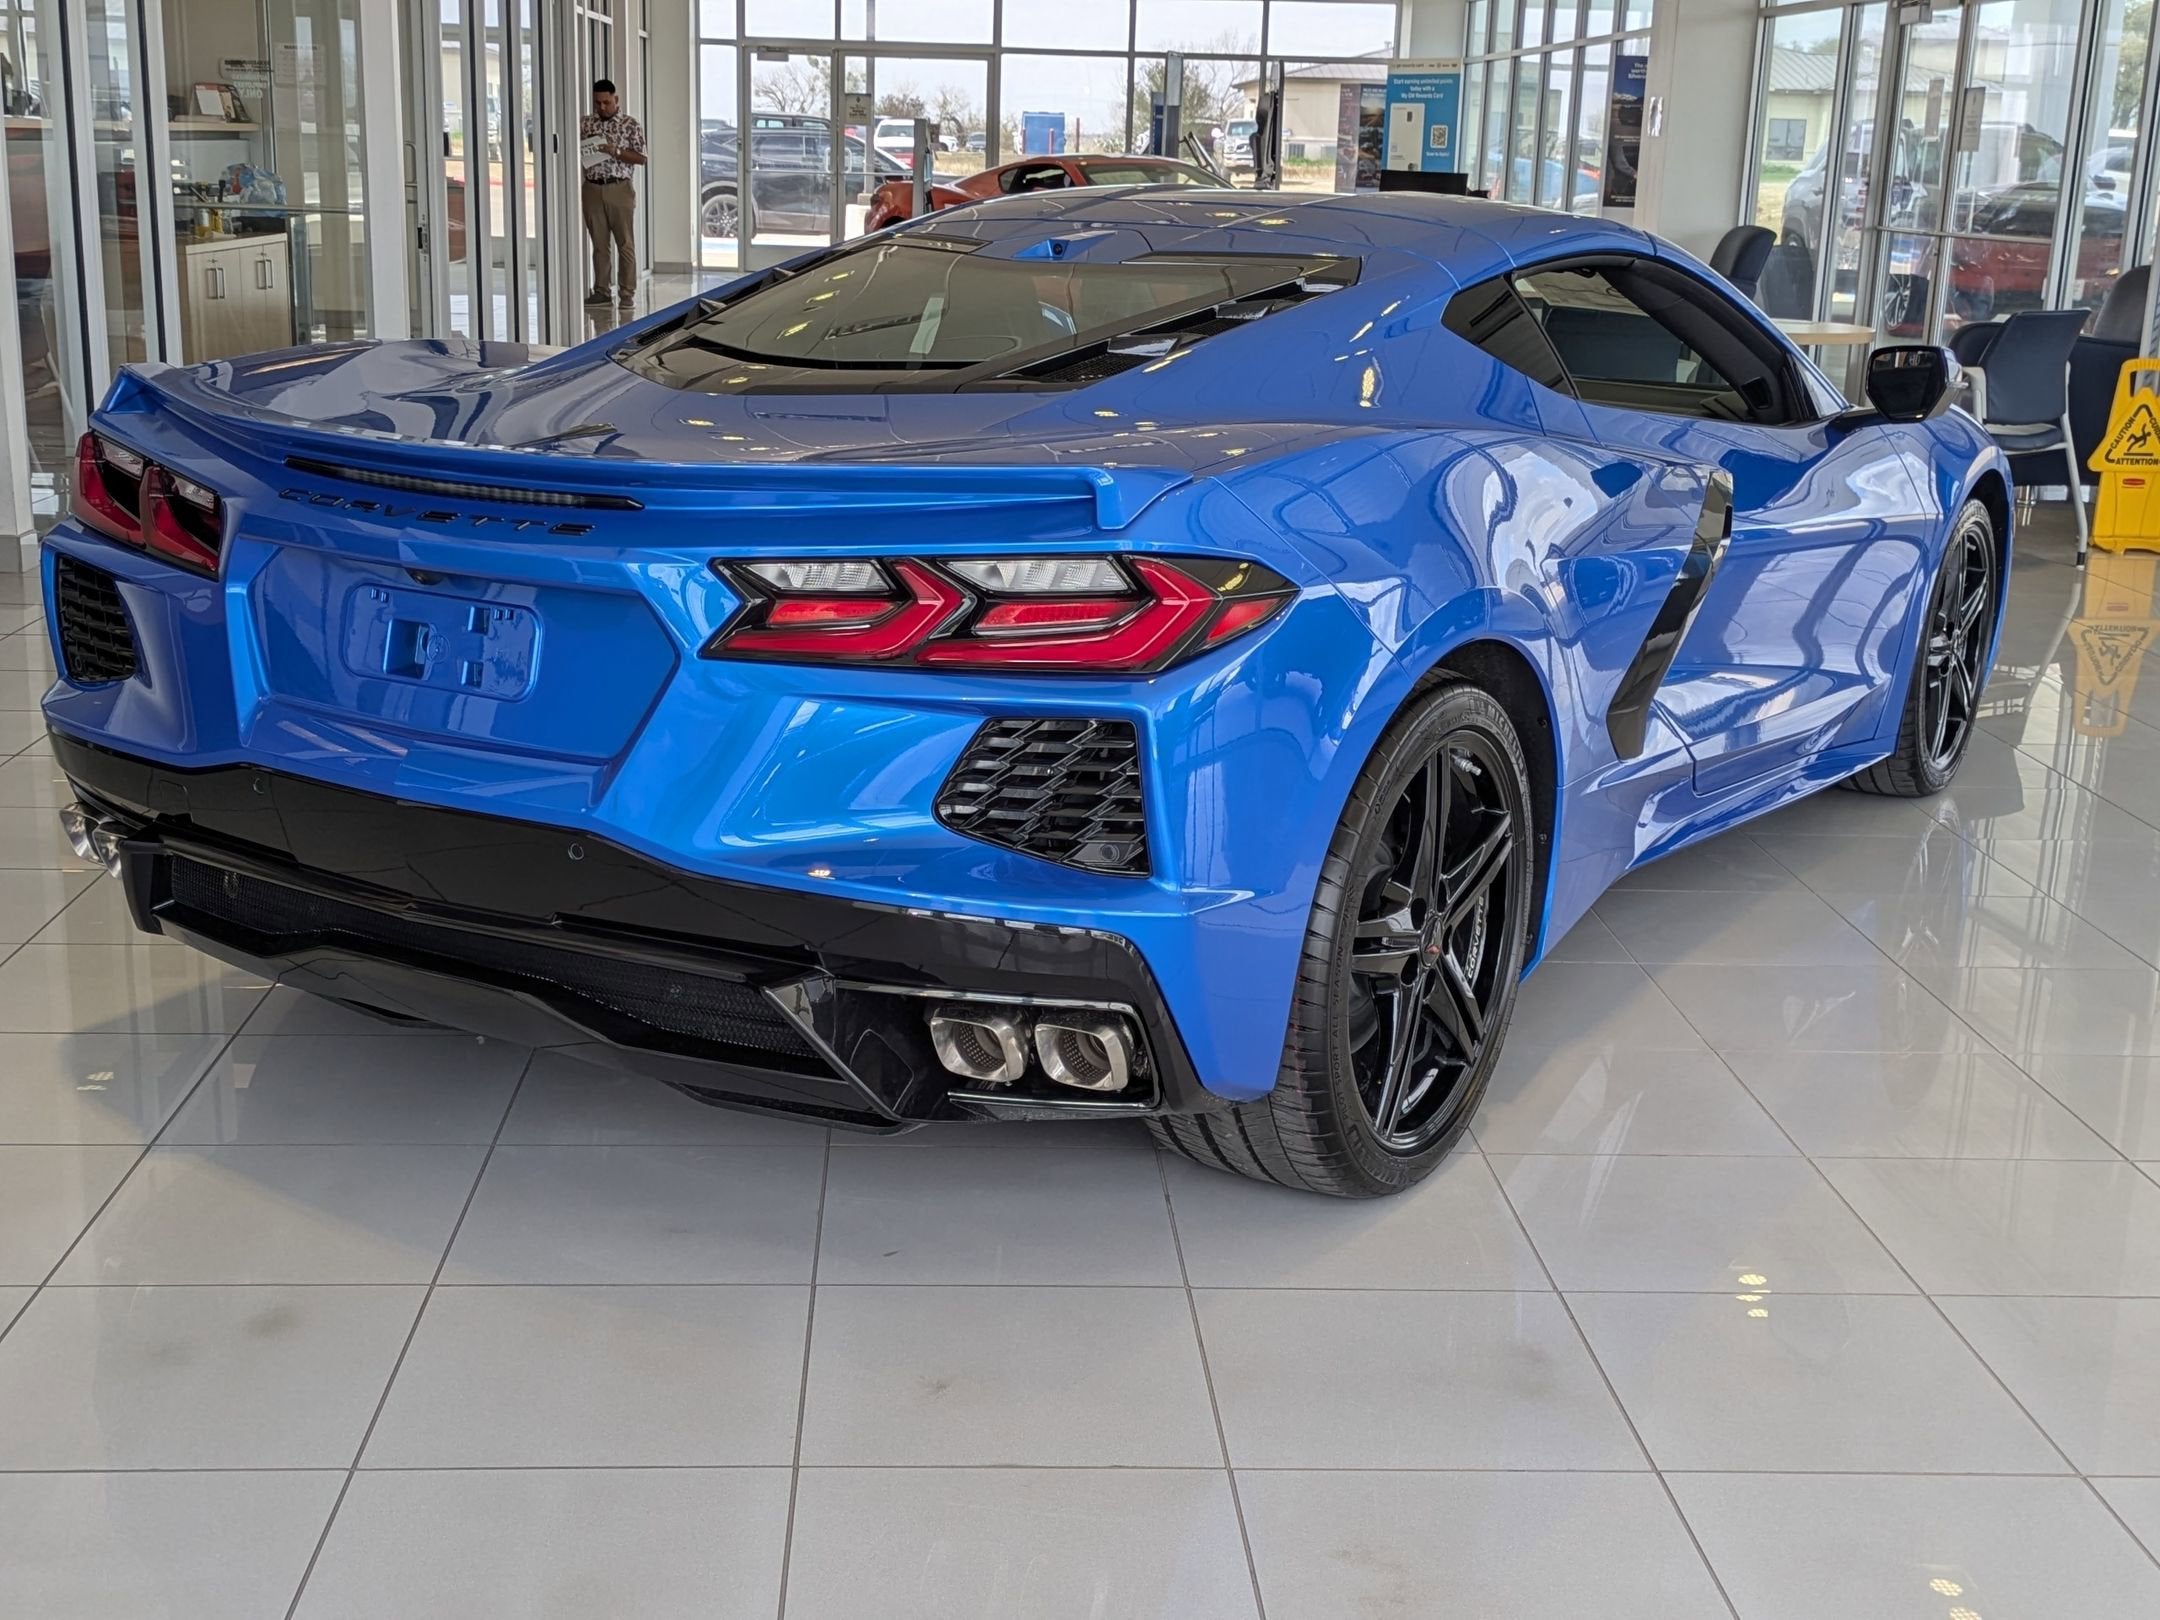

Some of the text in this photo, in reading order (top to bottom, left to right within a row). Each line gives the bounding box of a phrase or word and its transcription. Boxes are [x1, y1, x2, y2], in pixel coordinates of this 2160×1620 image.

[2110, 417, 2135, 450] CAUTION
[2115, 458, 2159, 466] ATTENTION
[279, 487, 595, 536] CORVETTE
[1487, 704, 1524, 771] MICHELIN
[1468, 896, 1484, 979] CORVETTE
[1333, 946, 1344, 1006] SEASON
[1332, 1015, 1340, 1038] ALL
[1332, 1045, 1342, 1086] SPORT
